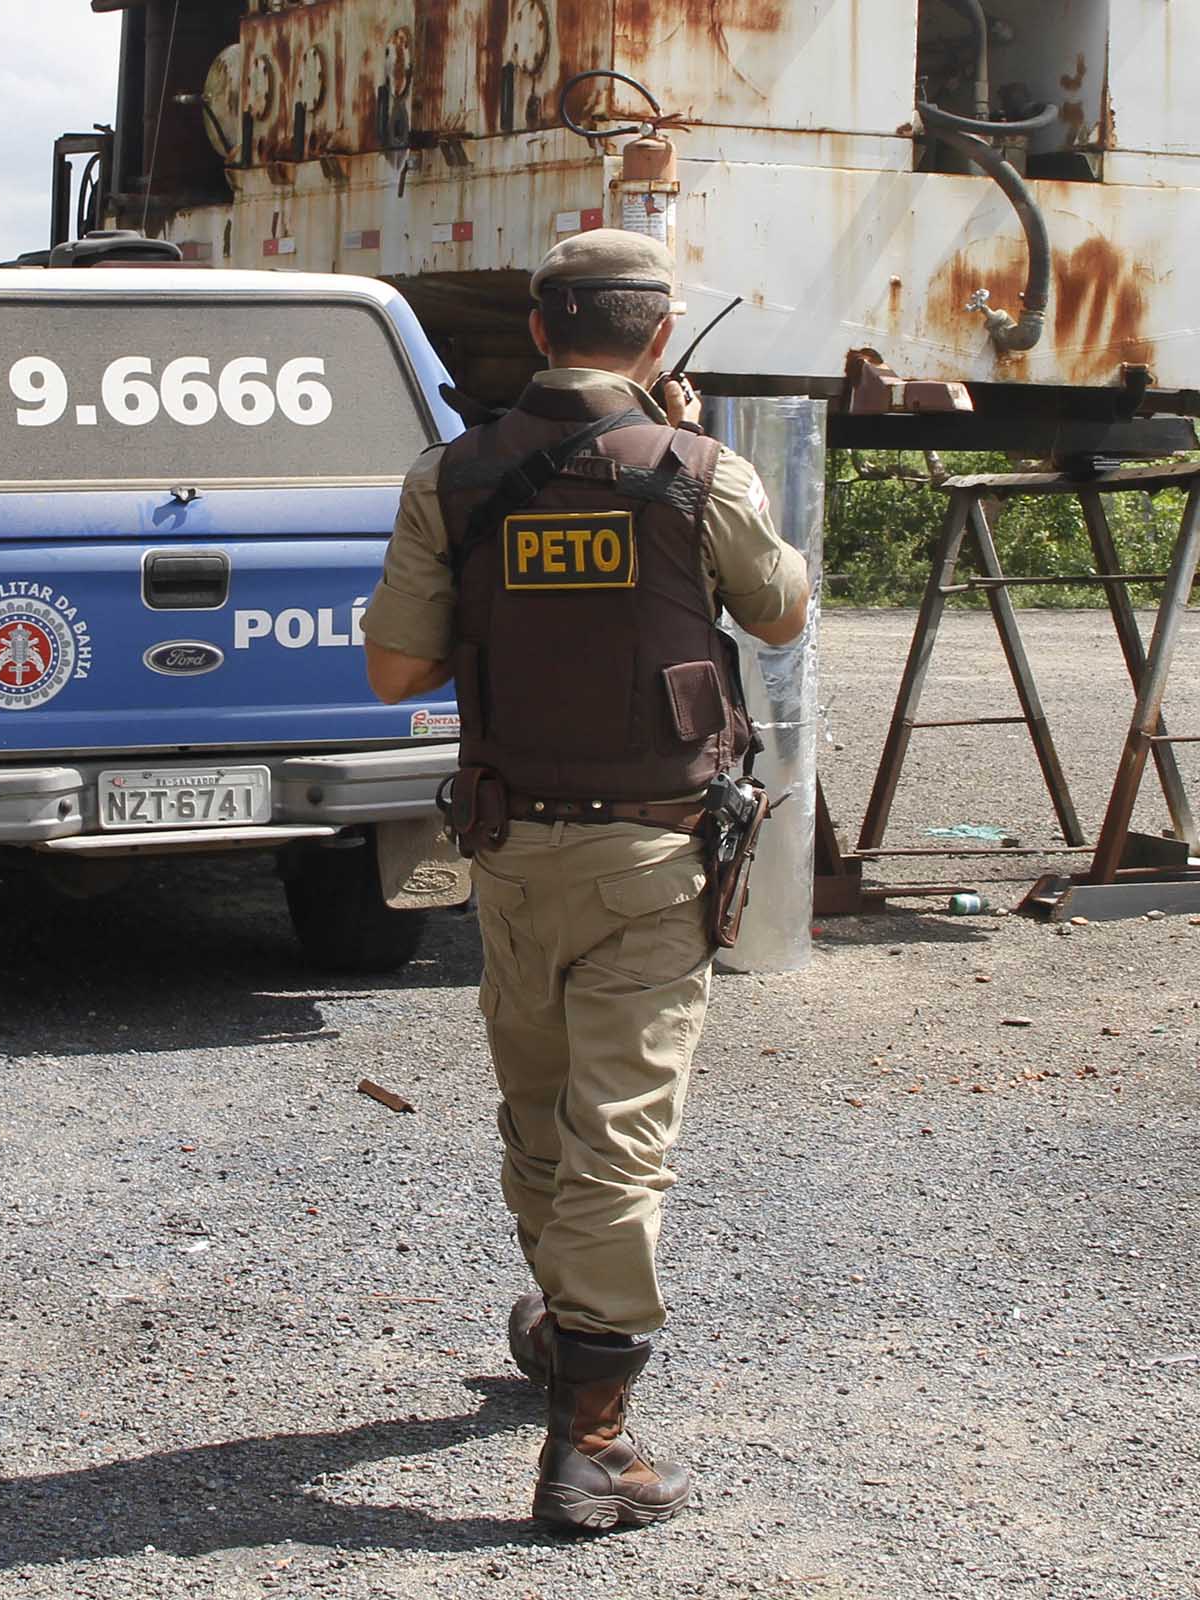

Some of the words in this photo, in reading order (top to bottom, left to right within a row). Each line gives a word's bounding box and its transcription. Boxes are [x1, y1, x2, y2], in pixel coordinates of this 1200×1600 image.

[8, 355, 333, 426] 9.6666
[516, 528, 621, 574] PETO
[54, 595, 78, 621] DA
[72, 620, 92, 679] BAHIA
[166, 648, 206, 666] Ford
